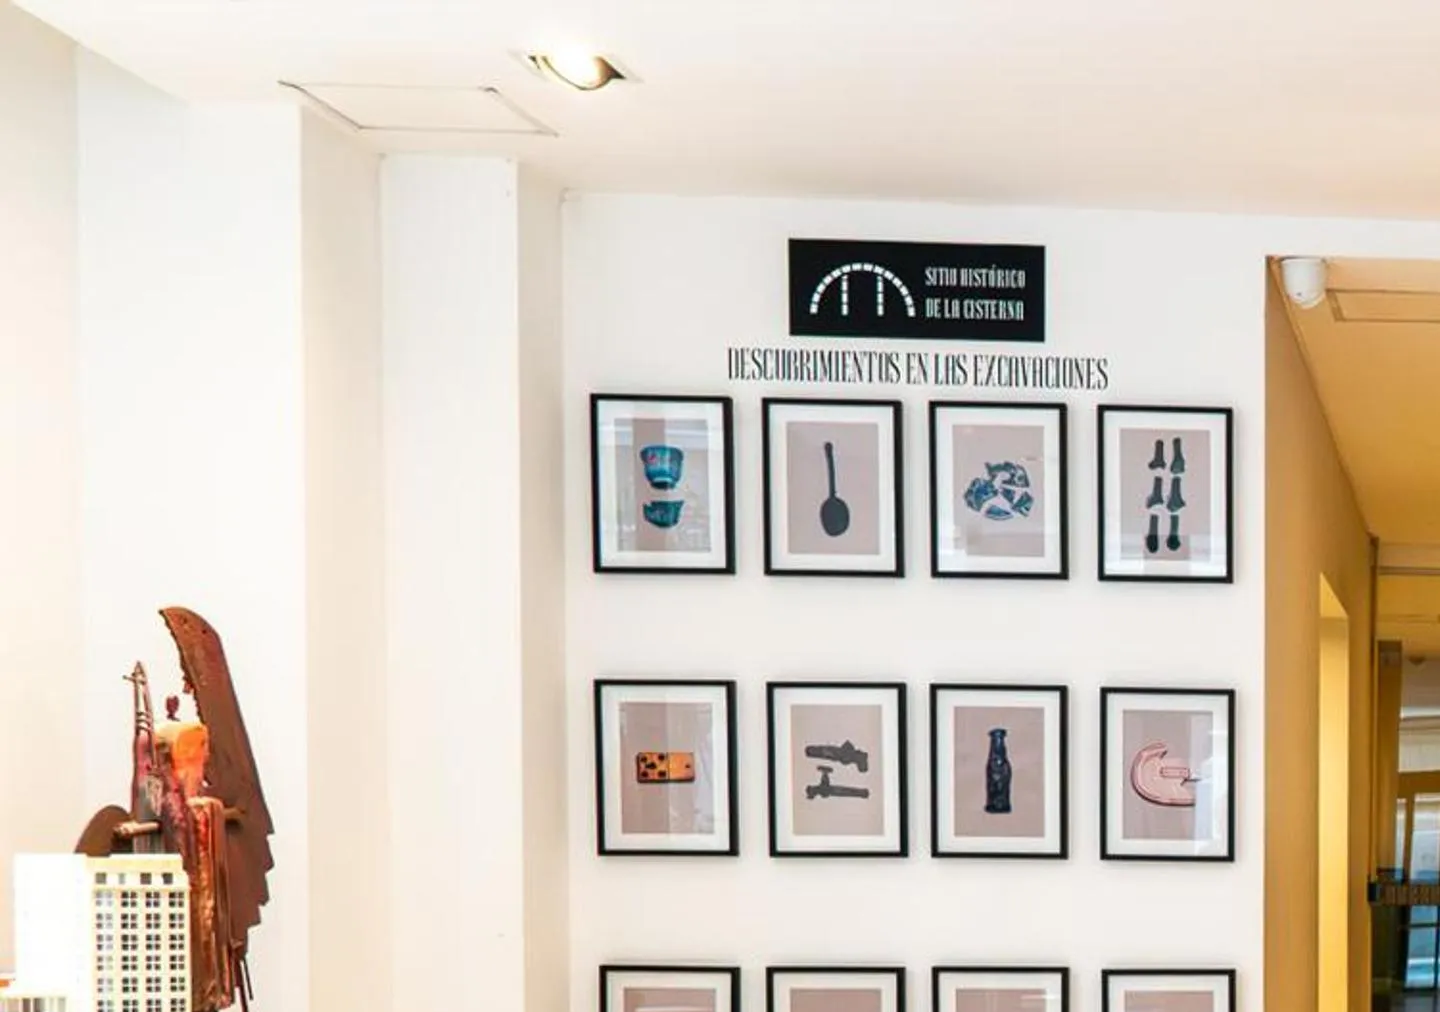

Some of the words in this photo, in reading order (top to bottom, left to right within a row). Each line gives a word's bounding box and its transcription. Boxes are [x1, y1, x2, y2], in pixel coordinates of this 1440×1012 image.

[924, 266, 957, 287] SITIO
[959, 263, 1026, 289] HISTÓRICO
[925, 297, 941, 318] DE
[943, 297, 960, 319] LA
[962, 298, 1025, 321] CISTERNA
[727, 346, 901, 384] DESCUBRIMIENTOS
[905, 351, 928, 384] EN
[933, 352, 967, 386] LAS
[972, 353, 1109, 391] EXCAVACIONES
